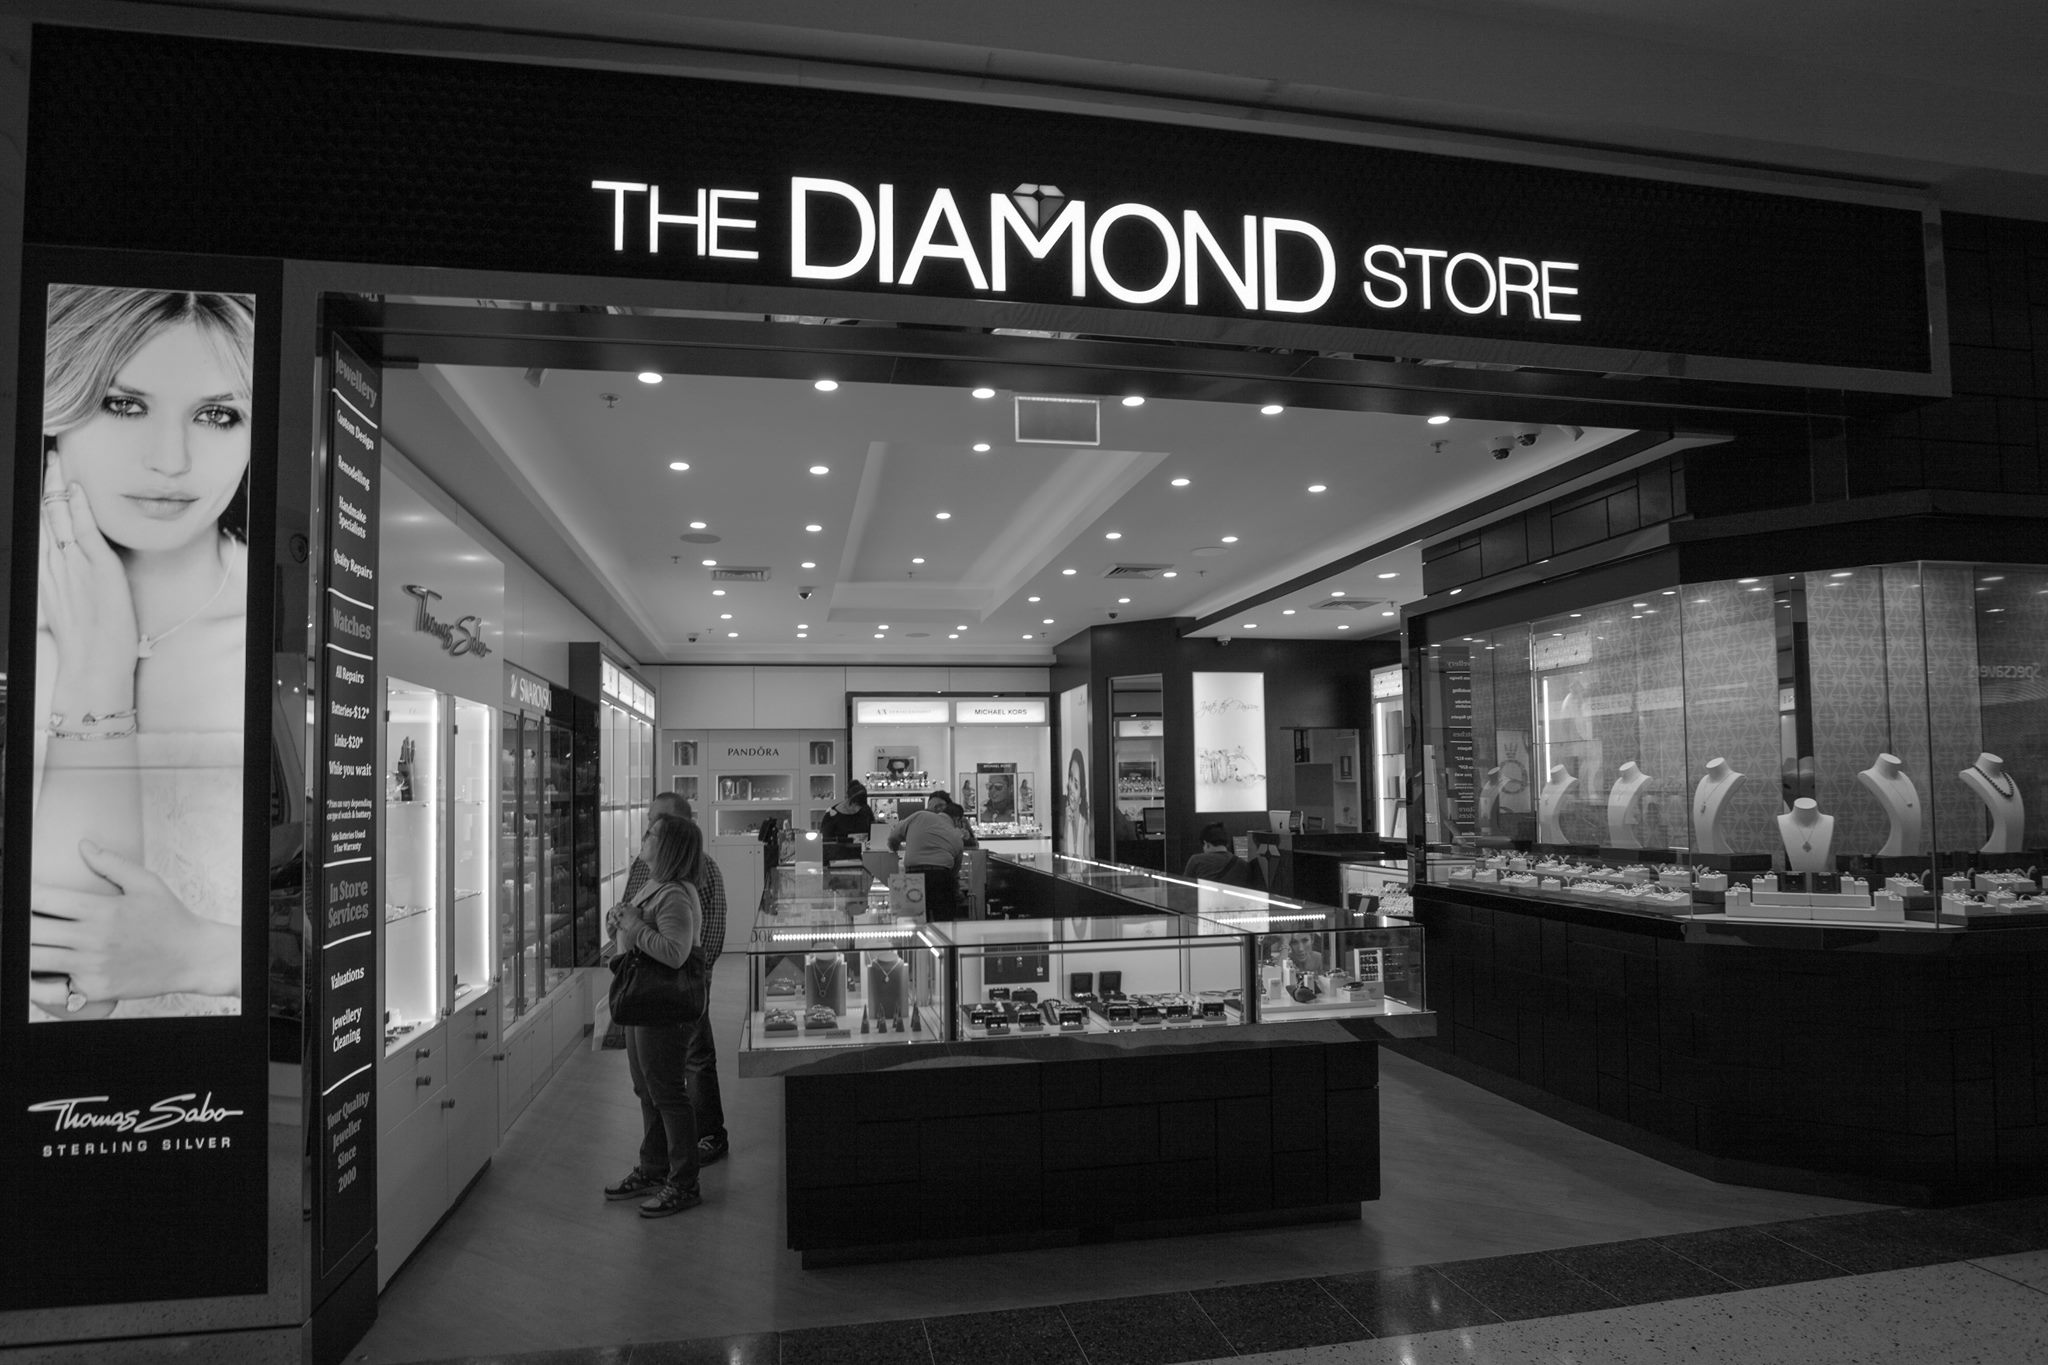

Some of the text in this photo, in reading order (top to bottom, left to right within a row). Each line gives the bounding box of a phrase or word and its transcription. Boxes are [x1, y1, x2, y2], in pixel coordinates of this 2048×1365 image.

[591, 176, 1583, 322] THE DIAMOND STORE
[336, 350, 377, 408] Jewellery
[350, 558, 373, 580] Repairs
[332, 607, 371, 640] Watches
[342, 666, 365, 685] Repairs
[342, 764, 355, 779] you
[355, 763, 372, 777] wait
[329, 880, 369, 904] In Store
[328, 902, 369, 929] Services
[330, 966, 365, 990] Valuations
[332, 1007, 362, 1035] Jewellery
[333, 1027, 361, 1053] Cleaning
[28, 1091, 244, 1133] Thomas Sabo
[342, 1091, 370, 1120] Quality
[42, 1136, 231, 1157] STERLING SILVER
[333, 1118, 362, 1153] Jeweller
[338, 1145, 357, 1170] Since
[338, 1165, 357, 1193] 2000
